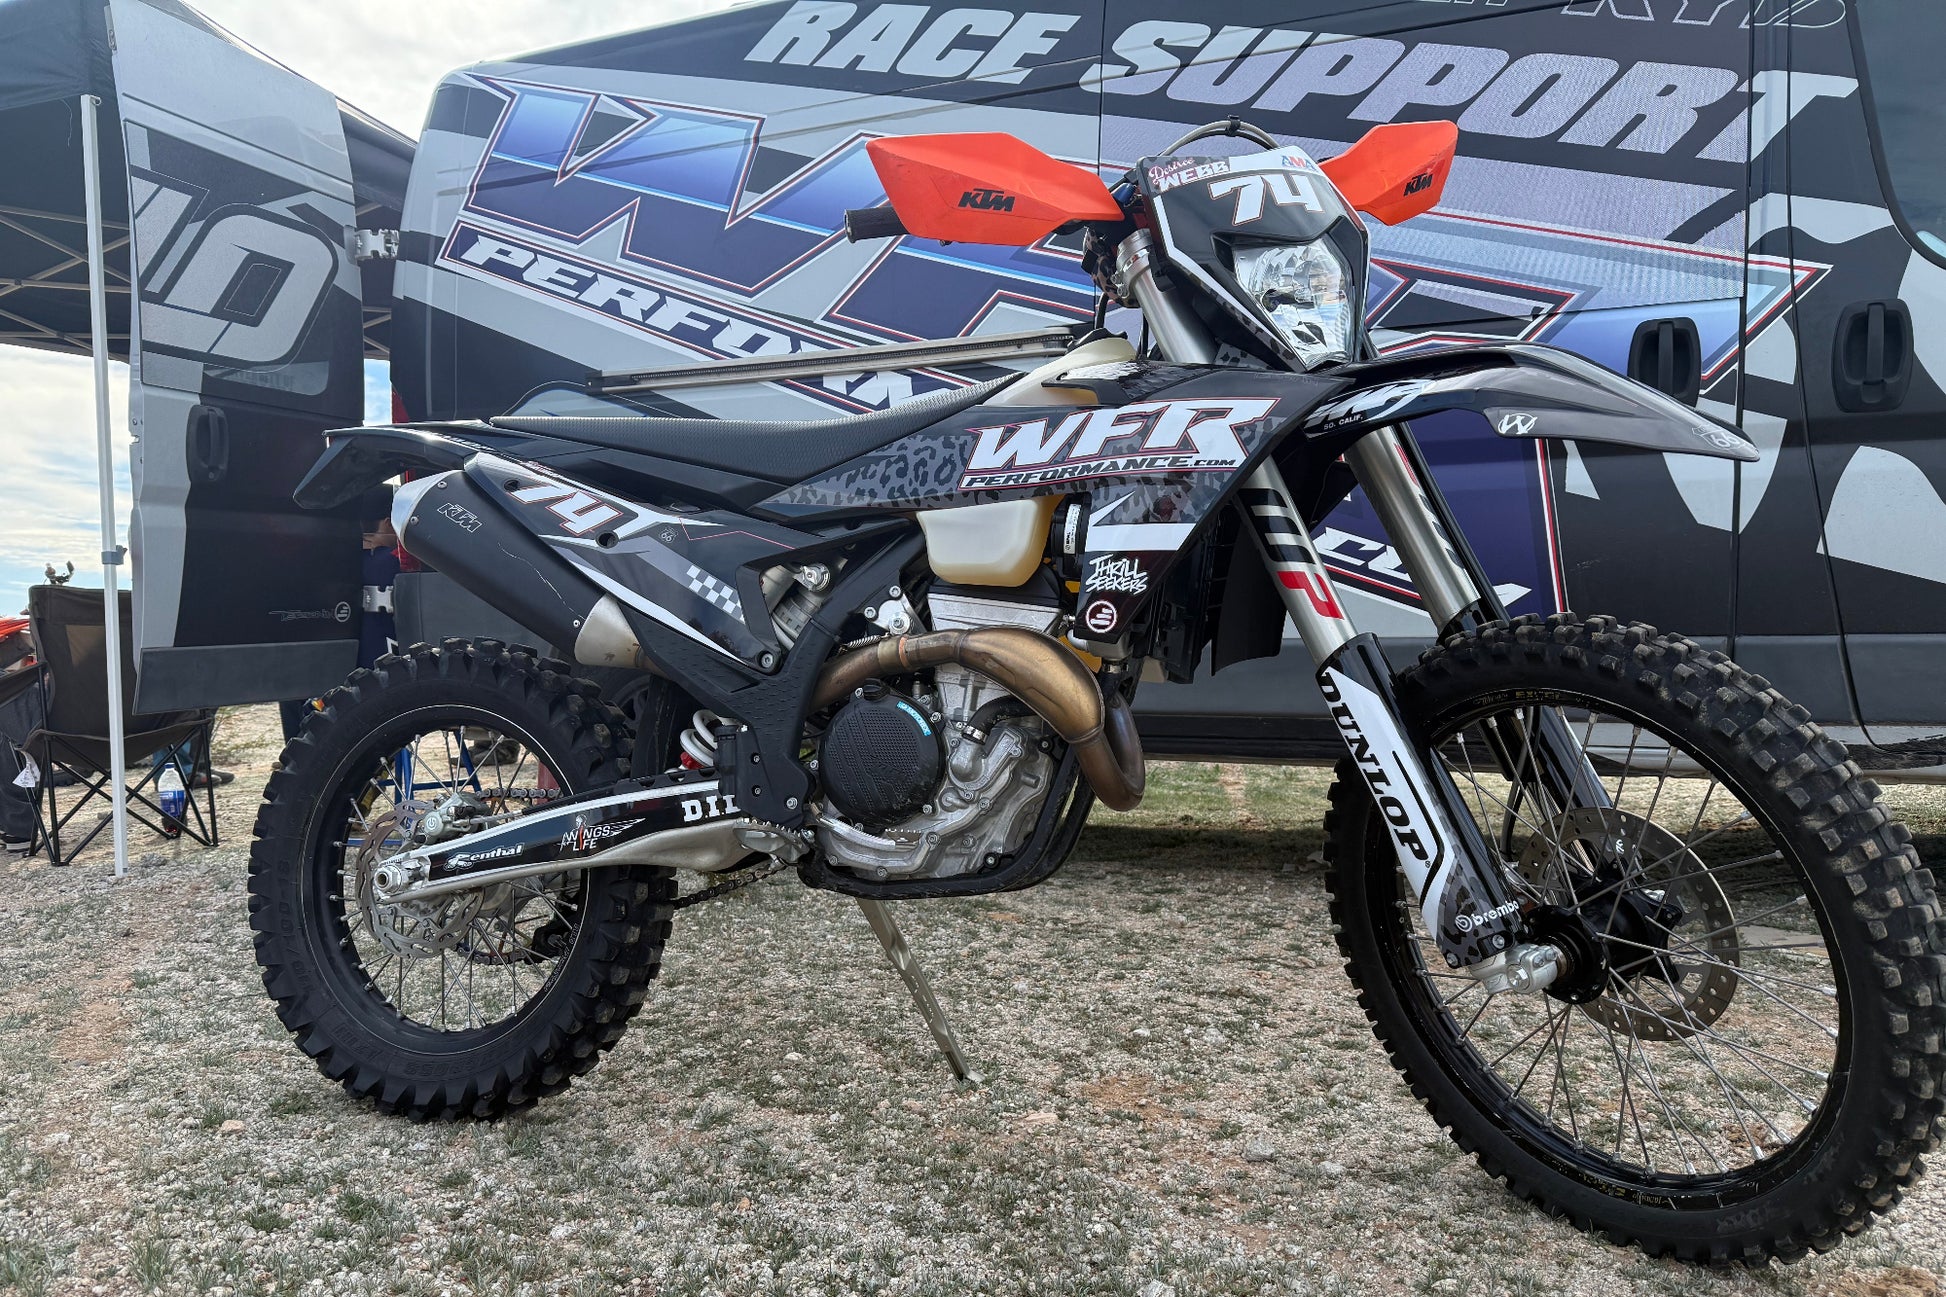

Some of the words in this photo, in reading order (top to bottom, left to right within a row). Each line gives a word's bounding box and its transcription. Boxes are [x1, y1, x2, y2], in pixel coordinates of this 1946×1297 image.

[743, 0, 1081, 84] RACE
[1078, 20, 1859, 164] SUPPORT
[1157, 161, 1230, 192] WEBB
[1281, 154, 1317, 172] AMA
[1403, 172, 1434, 197] KTM
[957, 188, 1016, 212] KTM
[1207, 174, 1325, 225] 74
[1338, 413, 1363, 426] CALIF.
[965, 399, 1279, 471] WFR
[436, 502, 483, 533] KTM
[505, 485, 624, 537] 74
[1089, 554, 1148, 579] THRILL
[1085, 575, 1149, 595] SEEKERS
[1318, 671, 1429, 861] DUNLOP
[443, 843, 523, 871] Renthal
[572, 838, 598, 852] LIFE
[1472, 899, 1519, 926] brembo
